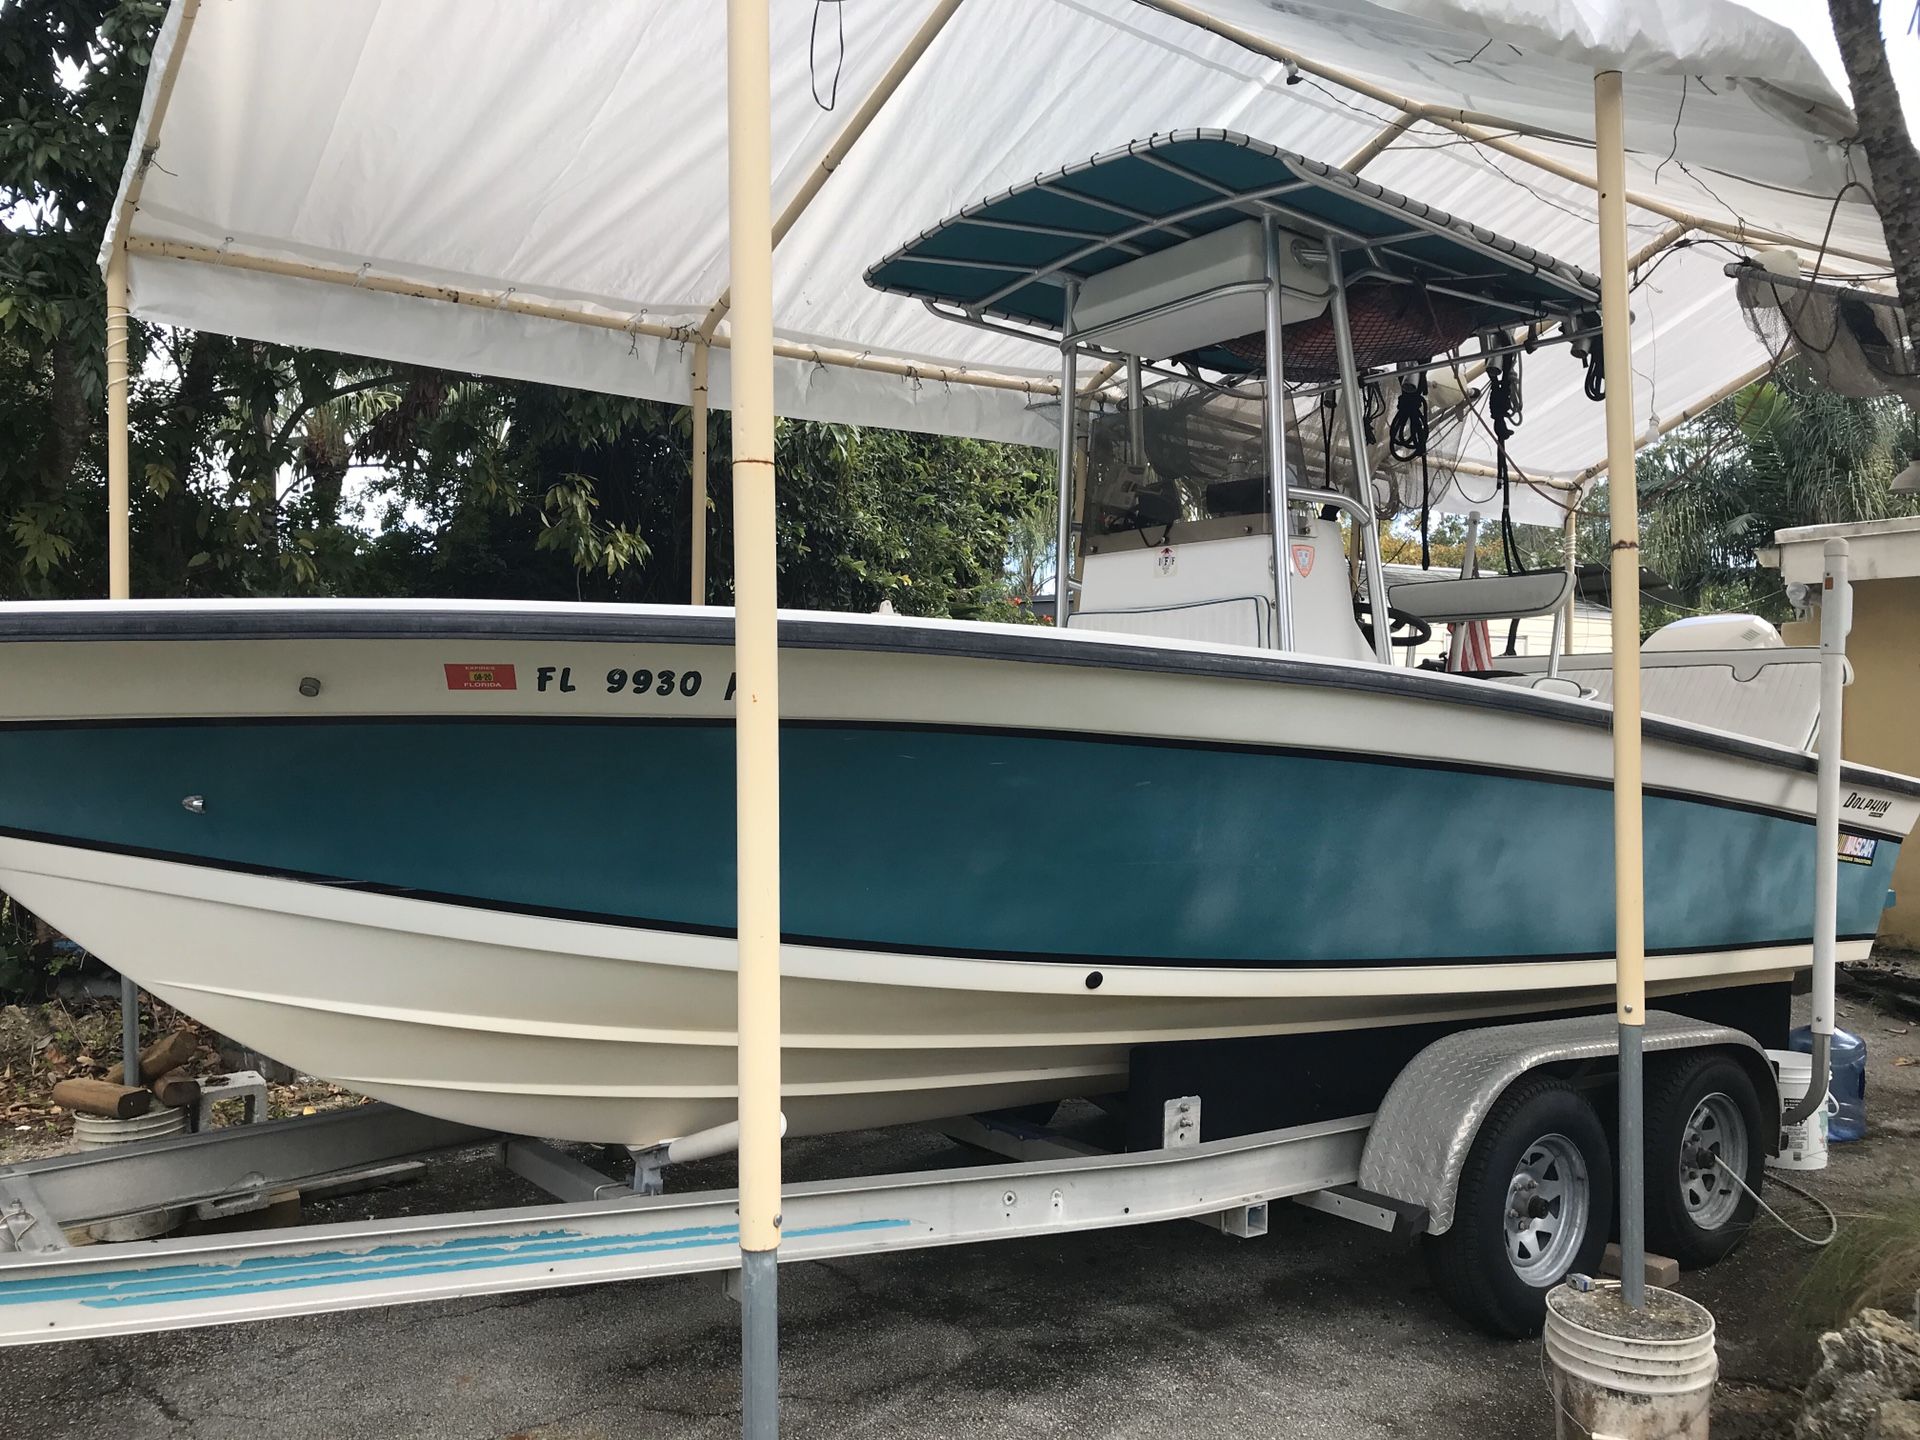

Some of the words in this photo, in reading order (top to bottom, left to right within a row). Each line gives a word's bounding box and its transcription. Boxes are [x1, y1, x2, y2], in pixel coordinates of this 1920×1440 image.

[537, 667, 576, 693] FL
[606, 668, 702, 697] 9930
[1843, 792, 1892, 813] DOLPHIN
